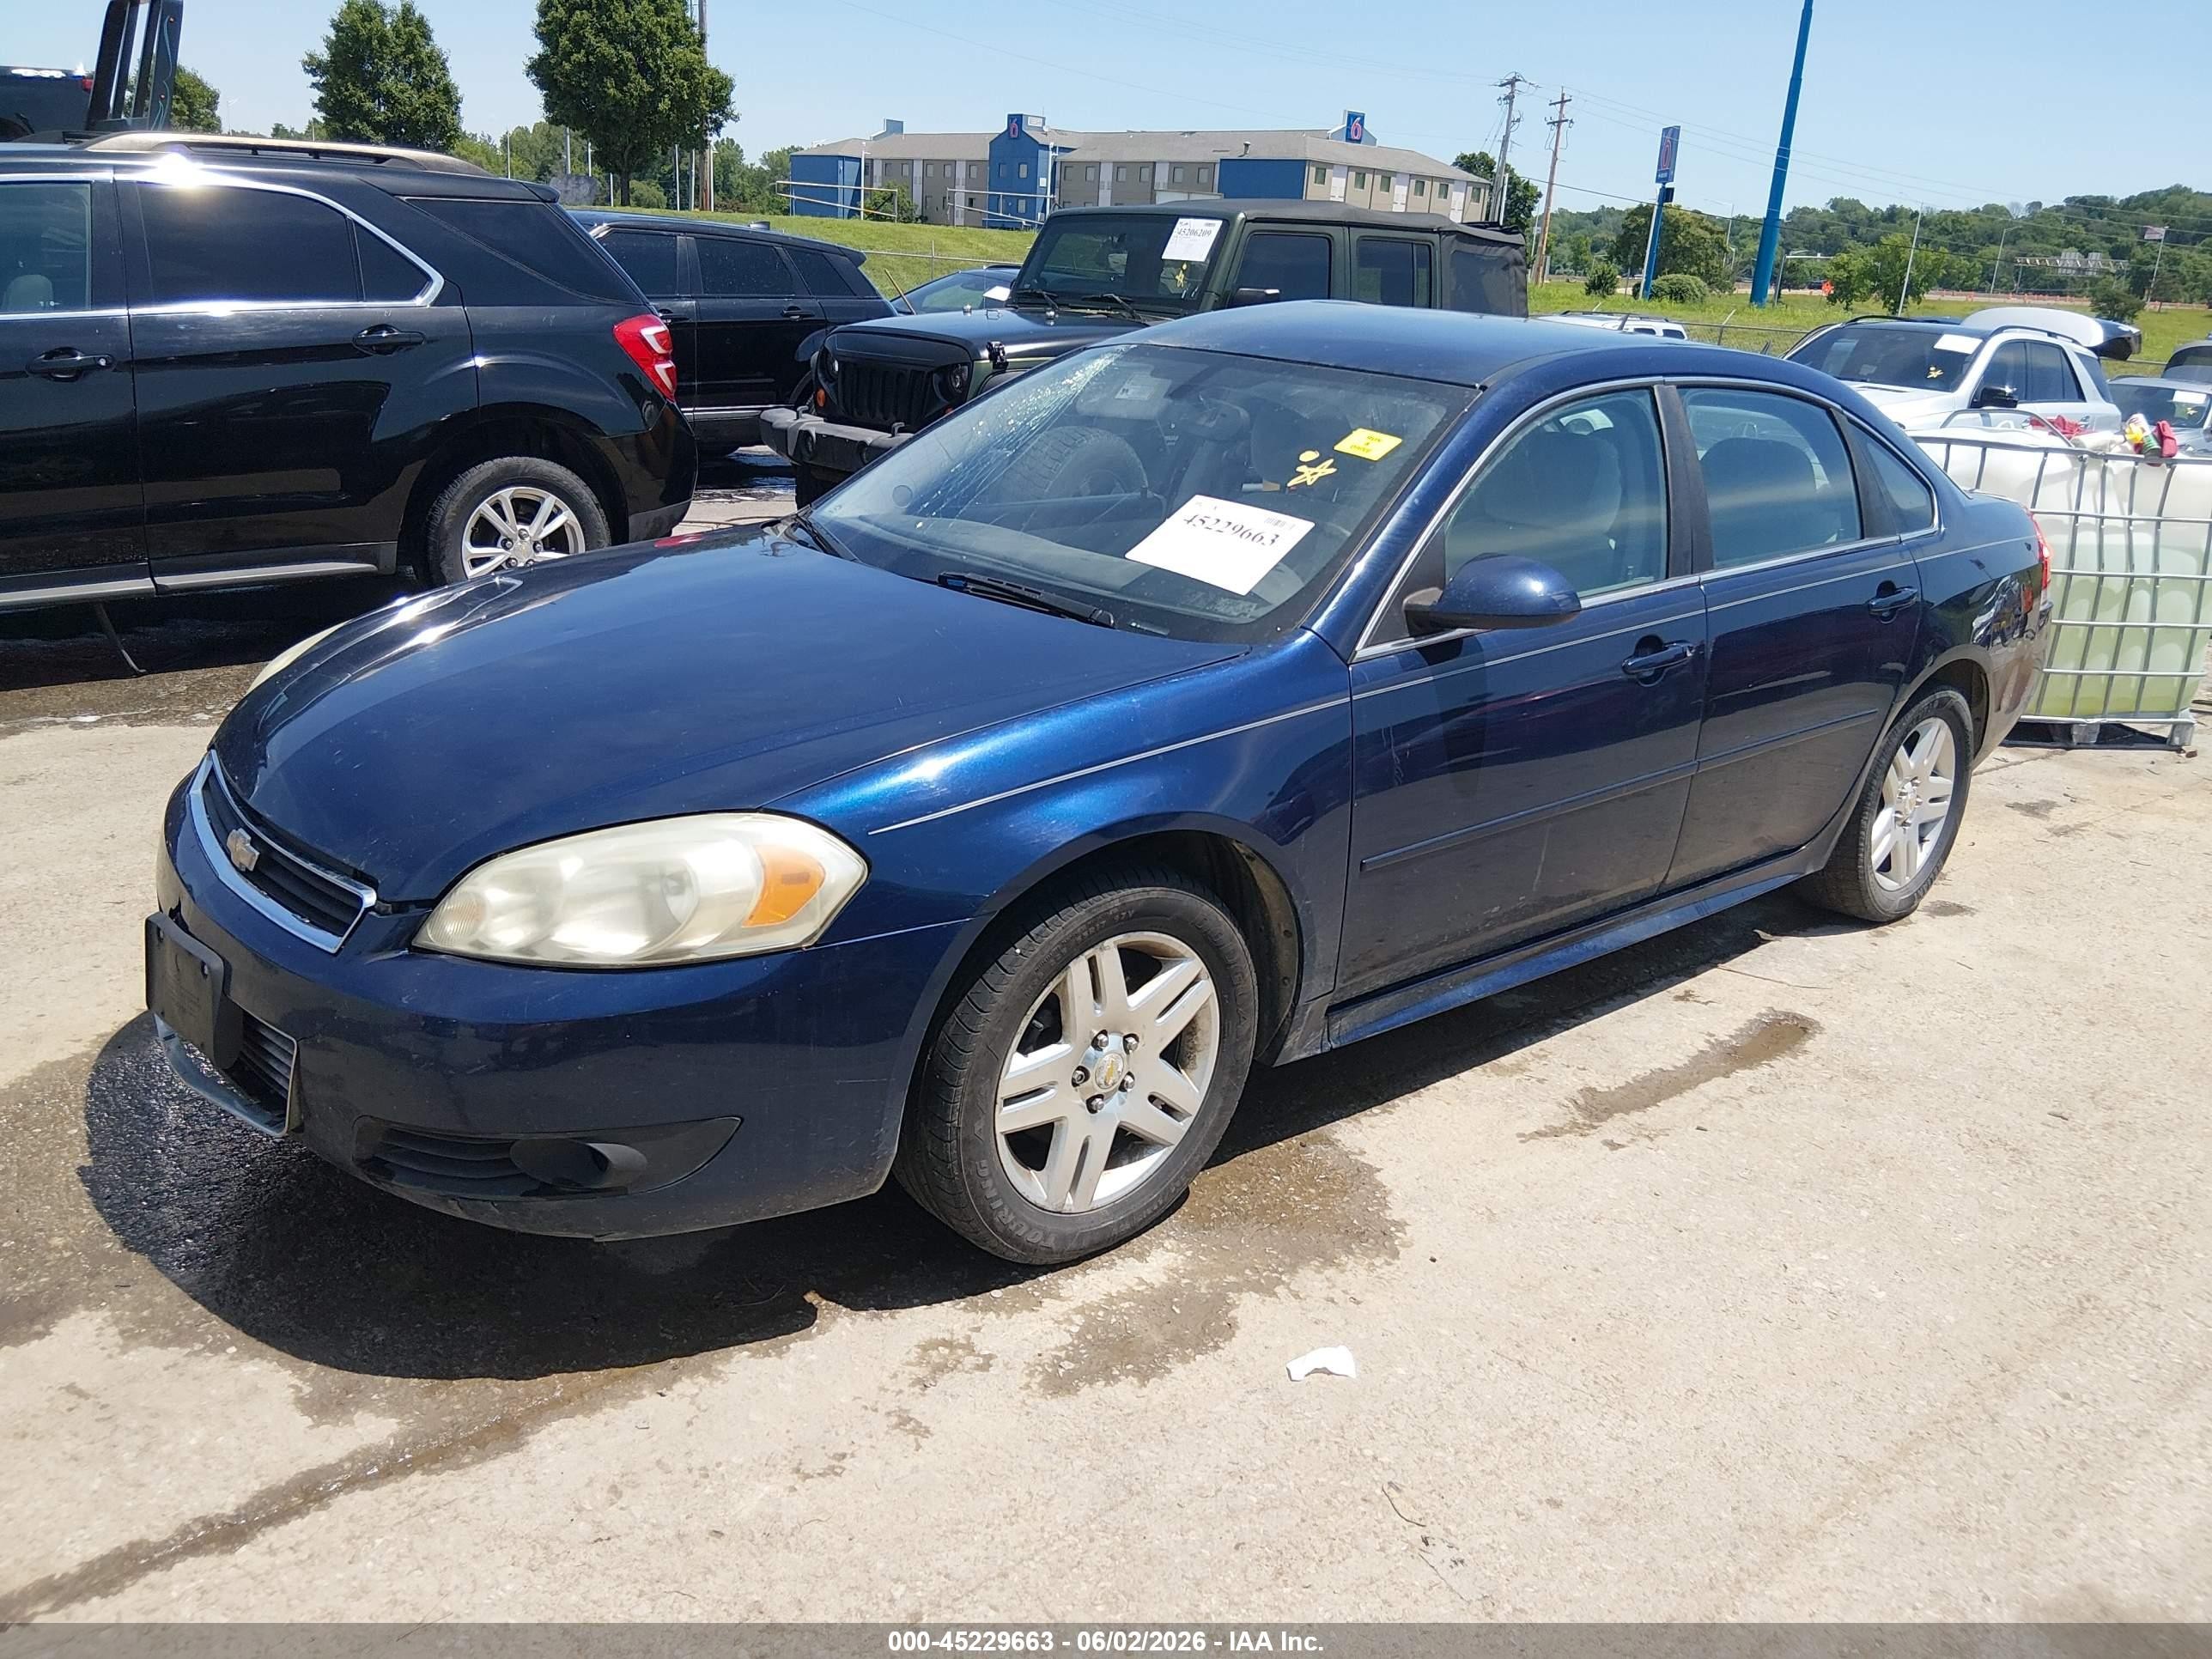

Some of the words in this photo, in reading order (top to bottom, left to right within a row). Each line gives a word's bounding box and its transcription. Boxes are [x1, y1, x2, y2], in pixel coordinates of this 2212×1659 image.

[1009, 118, 1018, 138] 6
[1350, 117, 1362, 140] 6
[1660, 129, 1673, 170] 6
[1183, 514, 1280, 547] 45229663
[975, 1159, 1056, 1248] TOURING
